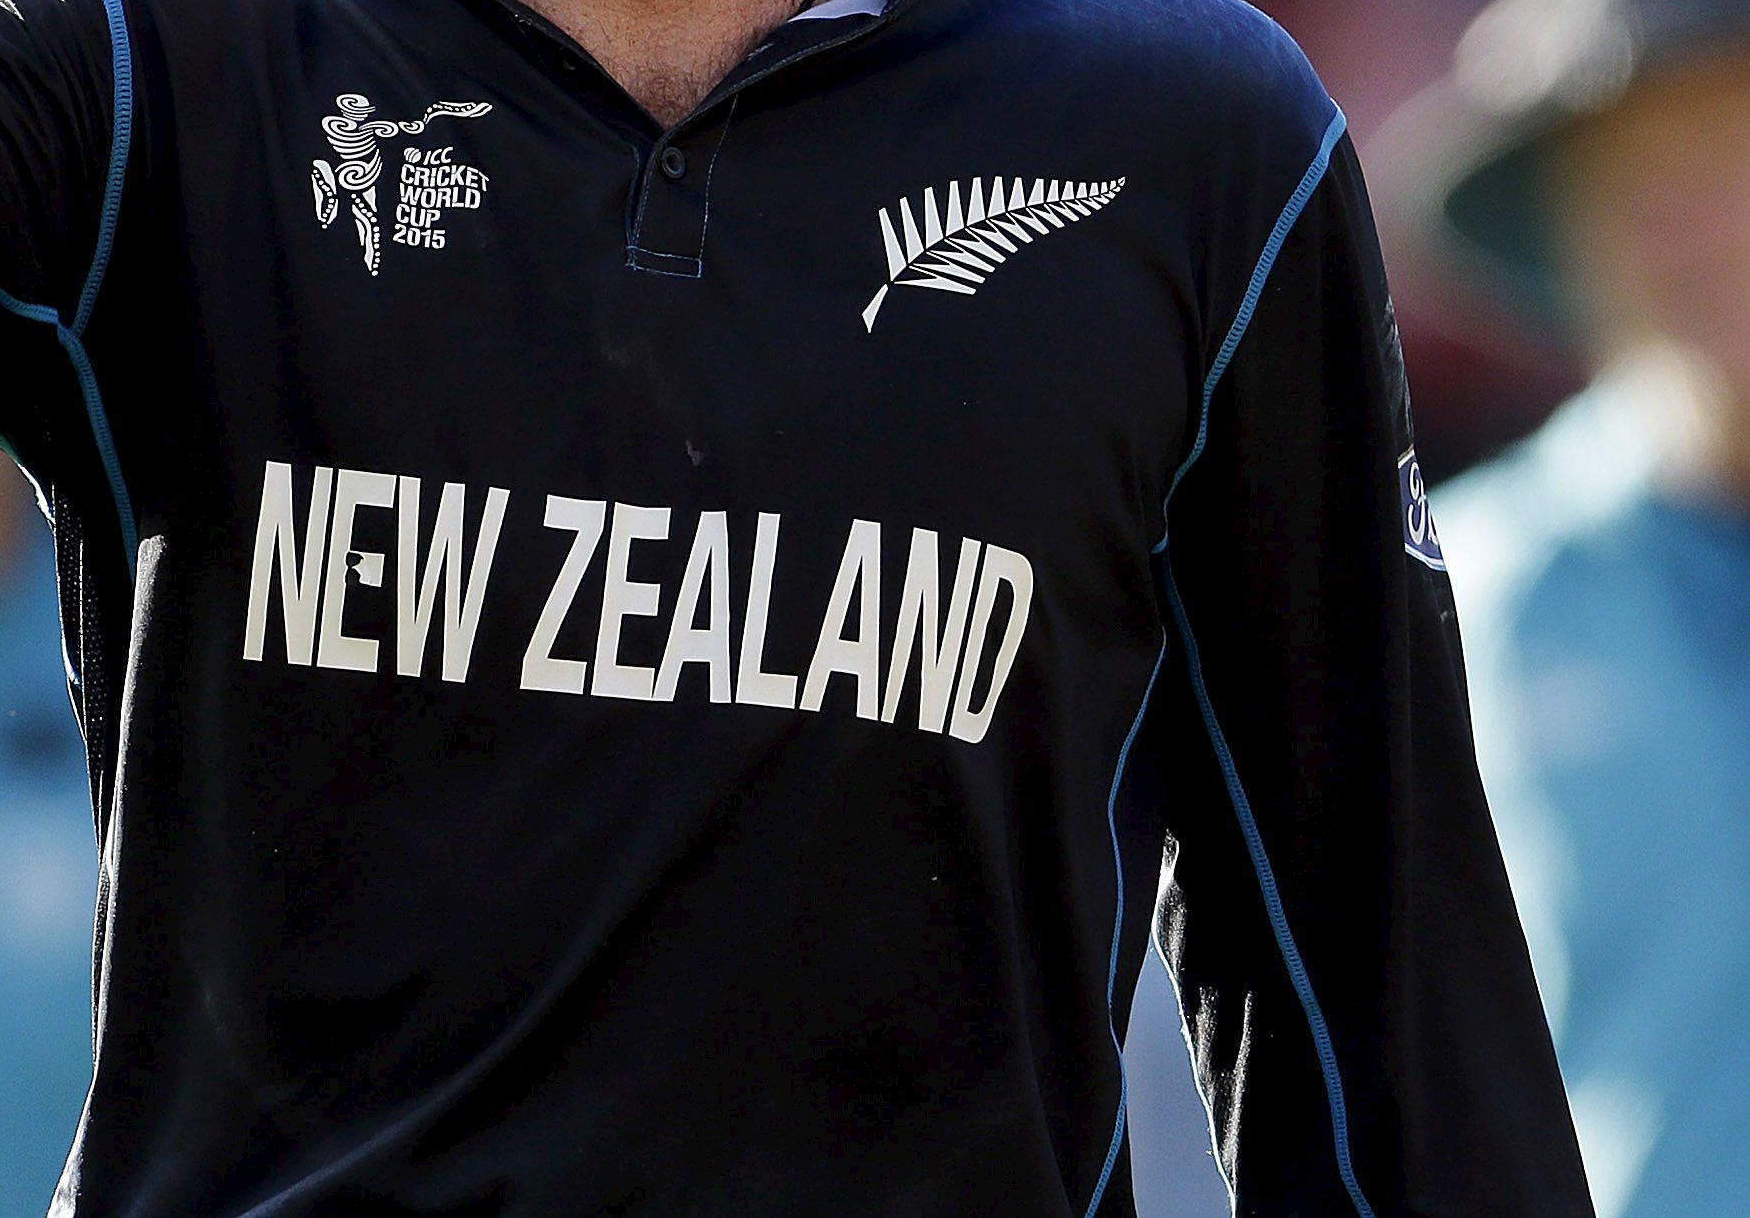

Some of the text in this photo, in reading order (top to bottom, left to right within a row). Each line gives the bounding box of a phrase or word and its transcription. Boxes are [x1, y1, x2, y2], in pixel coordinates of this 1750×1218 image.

[424, 147, 453, 165] ICC
[400, 163, 489, 191] CRICKET
[399, 184, 480, 209] WORLD
[396, 204, 440, 228] CUP
[393, 225, 445, 248] 2015
[242, 460, 1035, 746] NEW ZEALAND
